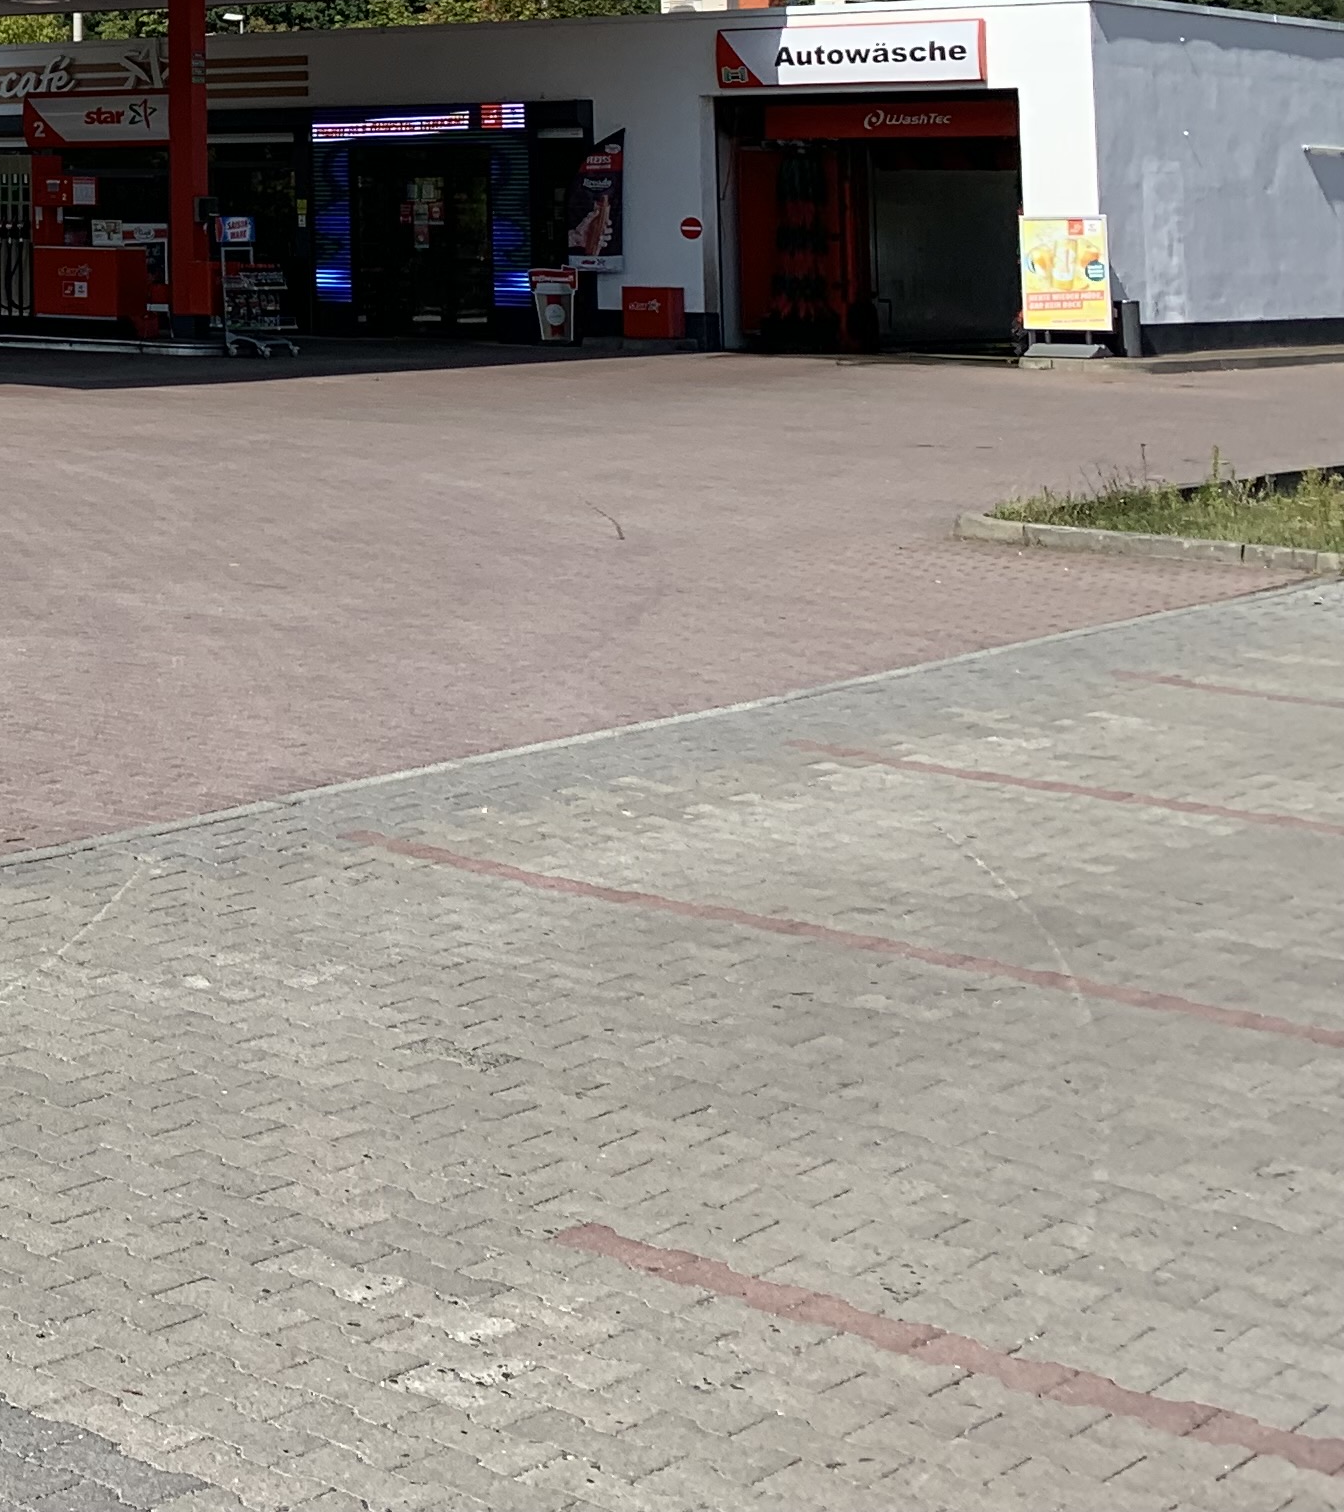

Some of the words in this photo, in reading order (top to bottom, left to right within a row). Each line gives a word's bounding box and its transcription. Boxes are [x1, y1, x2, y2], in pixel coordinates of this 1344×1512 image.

[775, 41, 967, 67] Autowäsche
[84, 107, 124, 125] star
[886, 112, 952, 125] WashTec
[33, 121, 46, 138] 2
